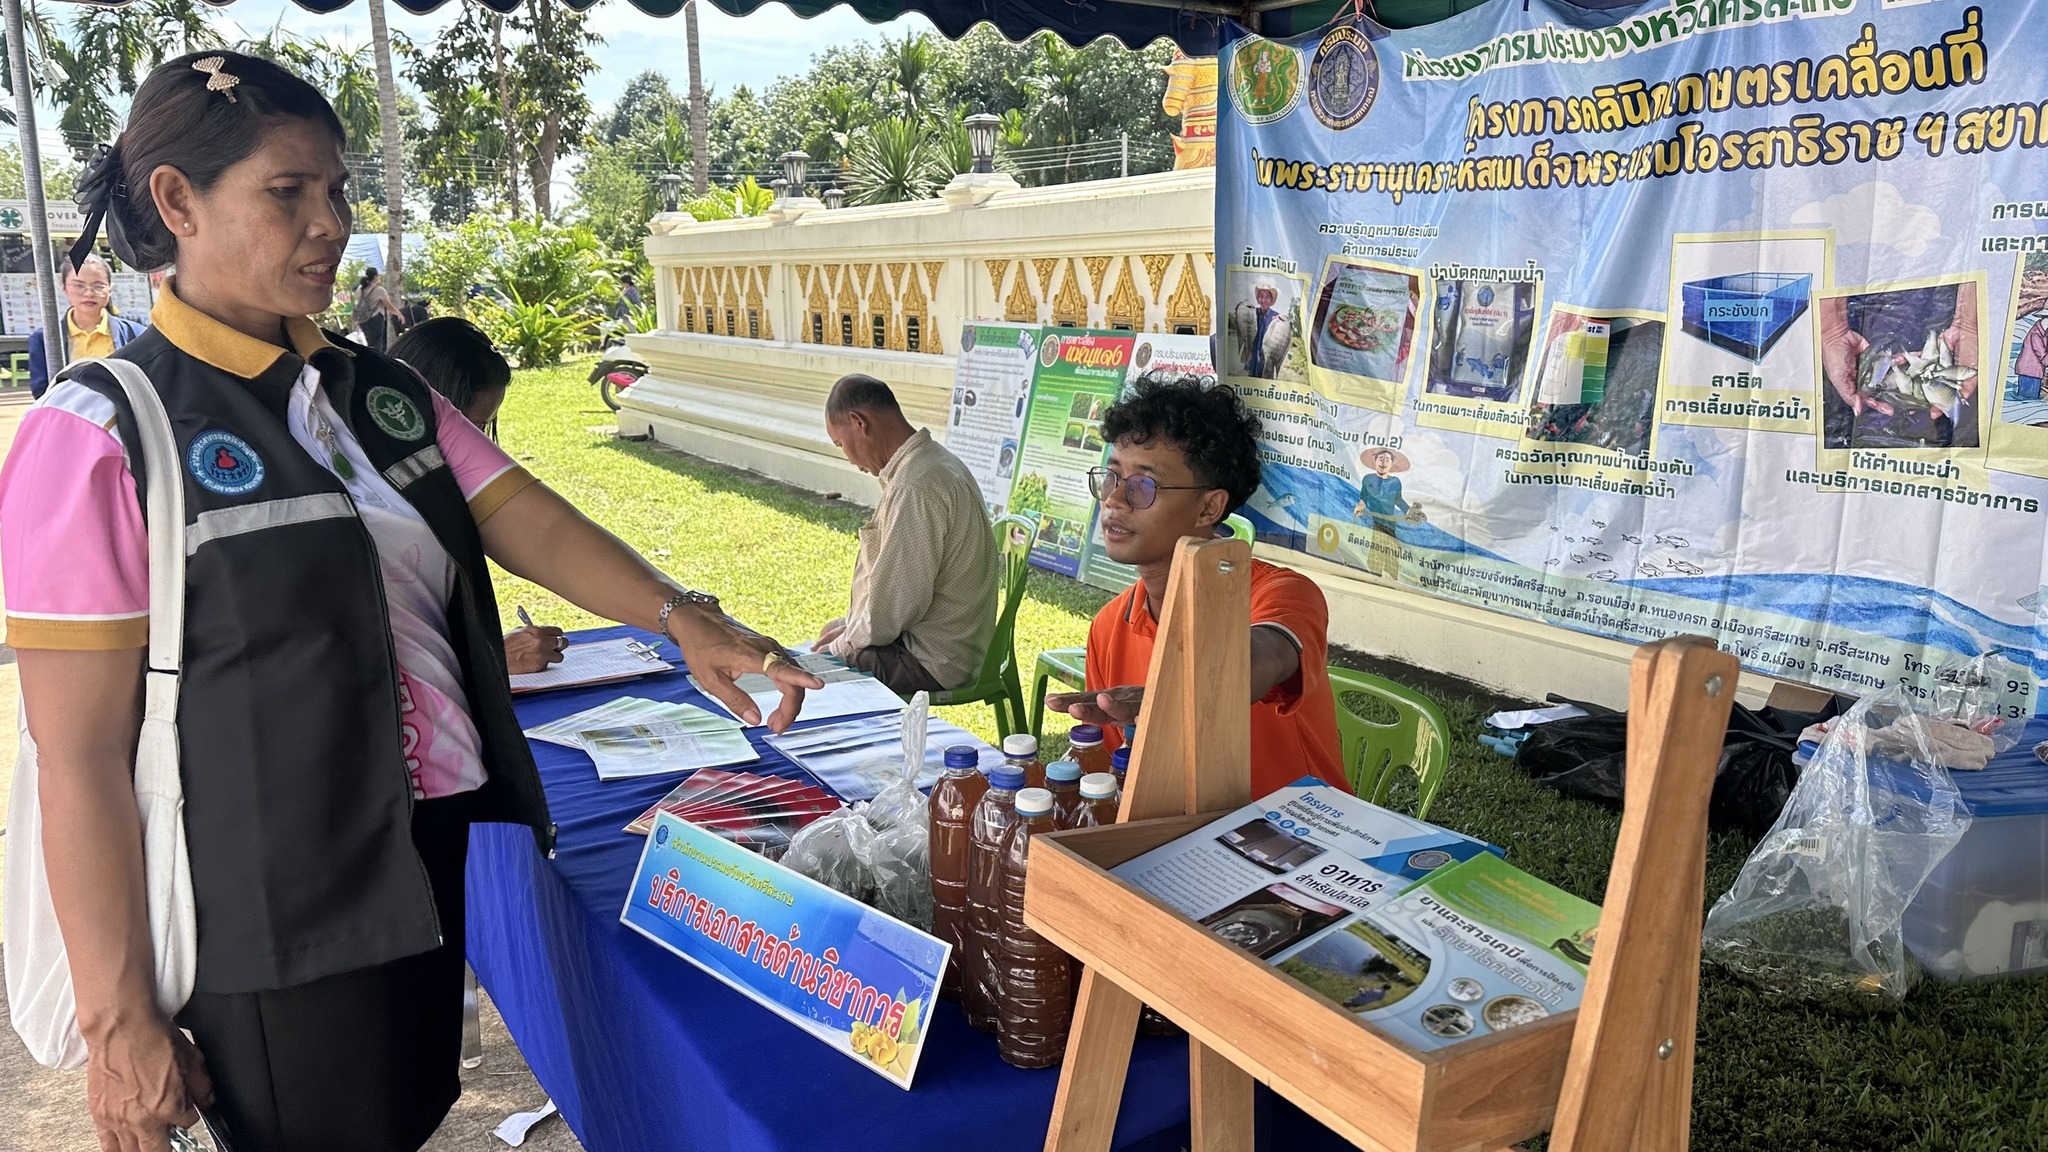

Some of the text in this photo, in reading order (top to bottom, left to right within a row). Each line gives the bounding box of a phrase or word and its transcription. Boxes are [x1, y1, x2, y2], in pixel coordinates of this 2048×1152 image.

[1319, 29, 1368, 57] กรมประมง
[1915, 114, 1947, 157] ฯ
[1342, 242, 1418, 258] ด้านการประมง
[1430, 260, 1544, 284] บำบัดคุณภาพน้ำ
[1708, 302, 1768, 318] กระชังบก
[1711, 372, 1762, 389] สาธิต
[1413, 399, 1530, 426] ในการเพาะเลี้ยงสัตว์น้ำ
[1665, 394, 1811, 421] การเลี้ยงสัตว์น้ำ
[1363, 431, 1403, 450] (ทบ.2)
[1496, 447, 1693, 476] ตรวจวัดคุณภาพน้ำเบื้องต้น
[1852, 451, 1960, 480] ให้คำแนะนำ
[1504, 470, 1675, 499] ในการเพาะเลี้ยงสัตว์น้ำ
[1786, 468, 2039, 513] และบริการเอกสารวิชาการ
[1348, 533, 1414, 563] ติดต่อสอบถามได้ที่
[1419, 557, 1567, 598] สำนักงานประมงจังหวัดศรีสะเกษ
[1577, 591, 1635, 612] ถ.รอบเมือง
[1639, 604, 1707, 627] ต.หนองครก
[1710, 618, 1811, 648] อ.เมืองศรีสะเกษ
[1815, 639, 1891, 667] จ.ศรีสะเกษ
[1722, 640, 1763, 659] ต.โพธิ์
[1762, 650, 1805, 670] อ.เมือง
[1810, 661, 1886, 689] จ.ศรีสะเกษ
[1299, 791, 1344, 819] โครงการ
[1295, 871, 1370, 909] สำหรับปลานิล
[1319, 862, 1383, 893] อาหาร
[648, 869, 906, 1038] บริการเอกสารด้านวิชาการ
[1420, 896, 1525, 959] ยาและสารเคมี
[1517, 957, 1577, 992] เพื่อการป้องกัน
[1421, 918, 1563, 1006] และ รักษาโรคสัตว์น้ำ
